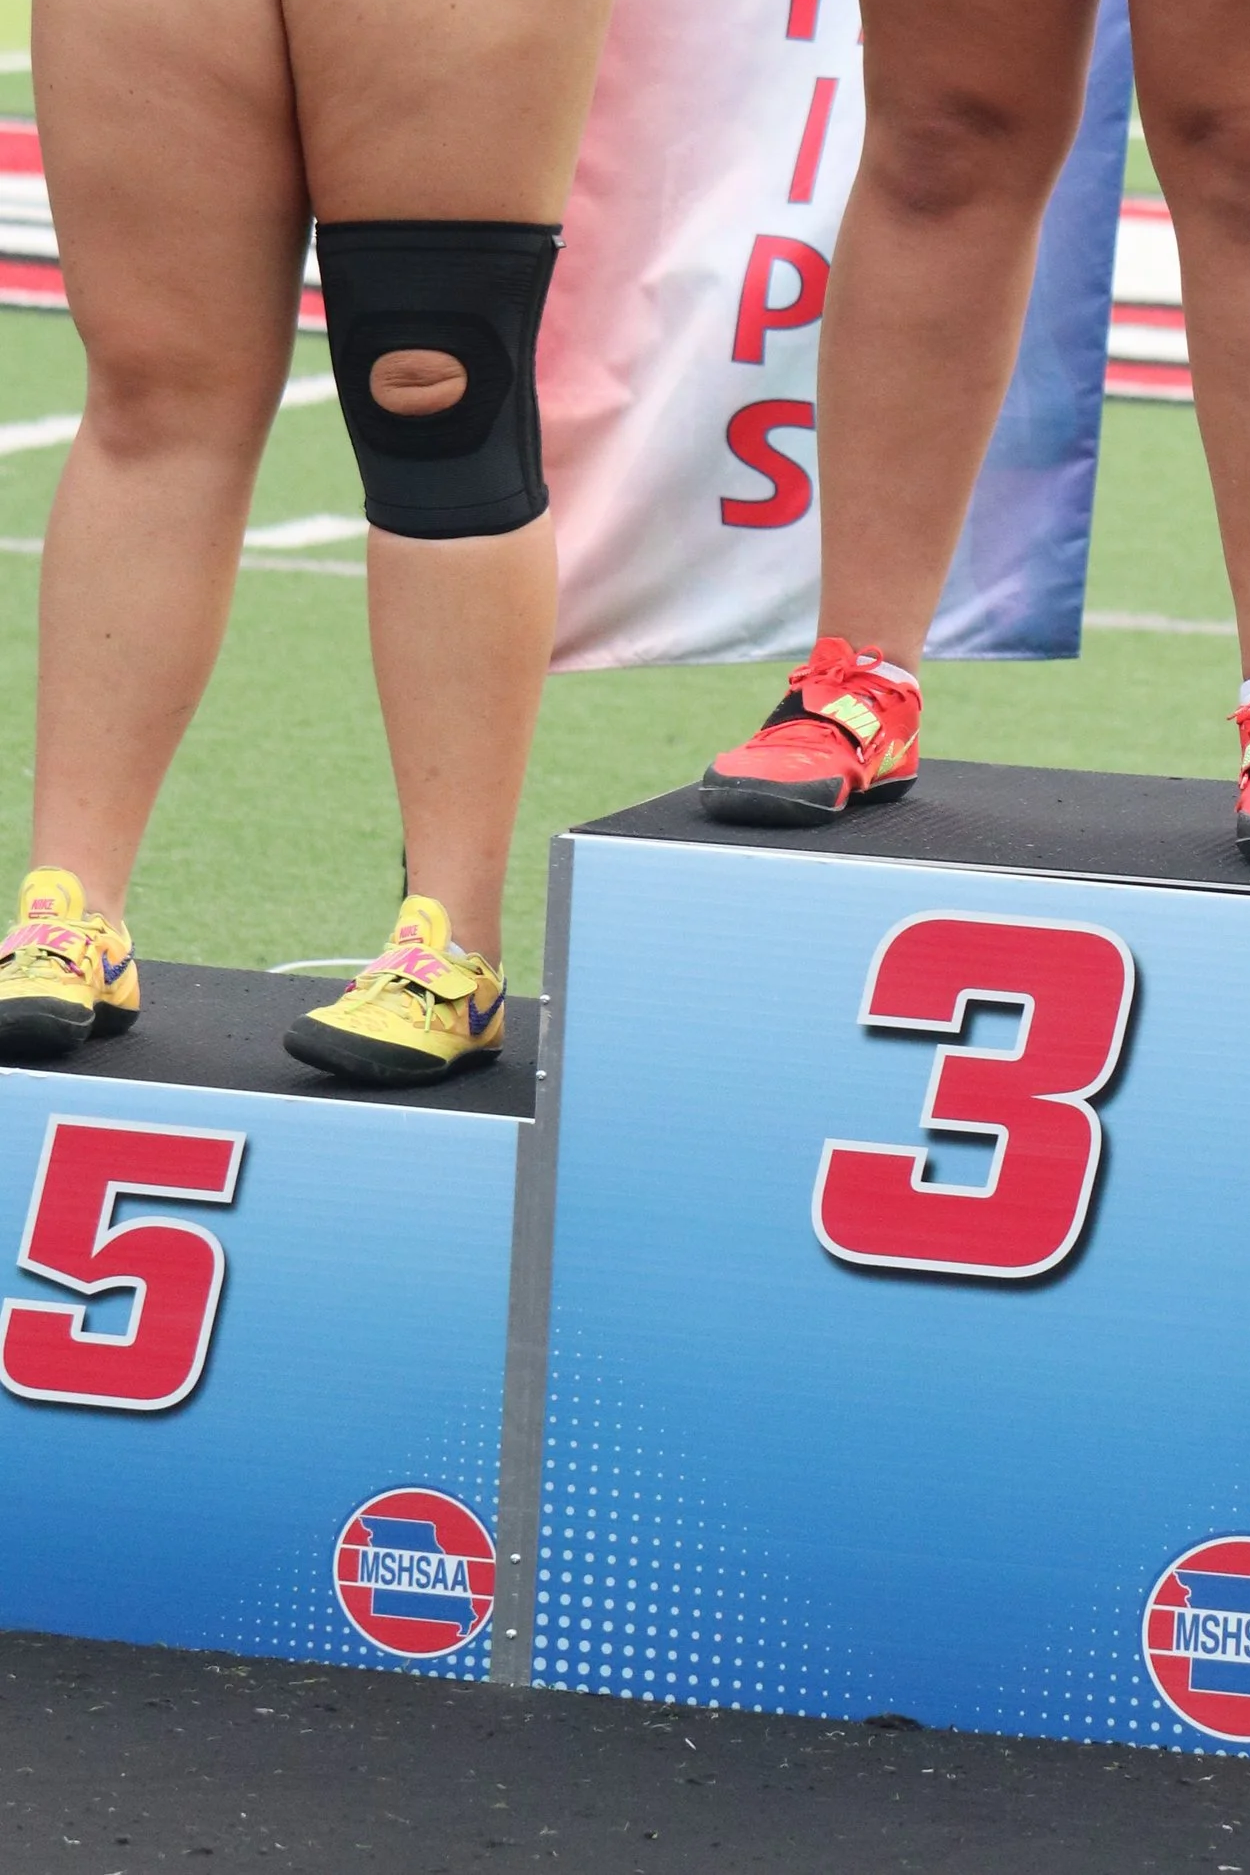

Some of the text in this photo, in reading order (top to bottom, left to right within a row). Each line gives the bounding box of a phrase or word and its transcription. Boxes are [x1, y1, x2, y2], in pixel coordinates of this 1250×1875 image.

[30, 898, 55, 911] NIKE
[400, 924, 419, 939] NIKE
[364, 946, 452, 985] NIKE
[812, 910, 1135, 1278] 3
[0, 1115, 247, 1410] 5
[360, 1549, 469, 1593] MSHSAA
